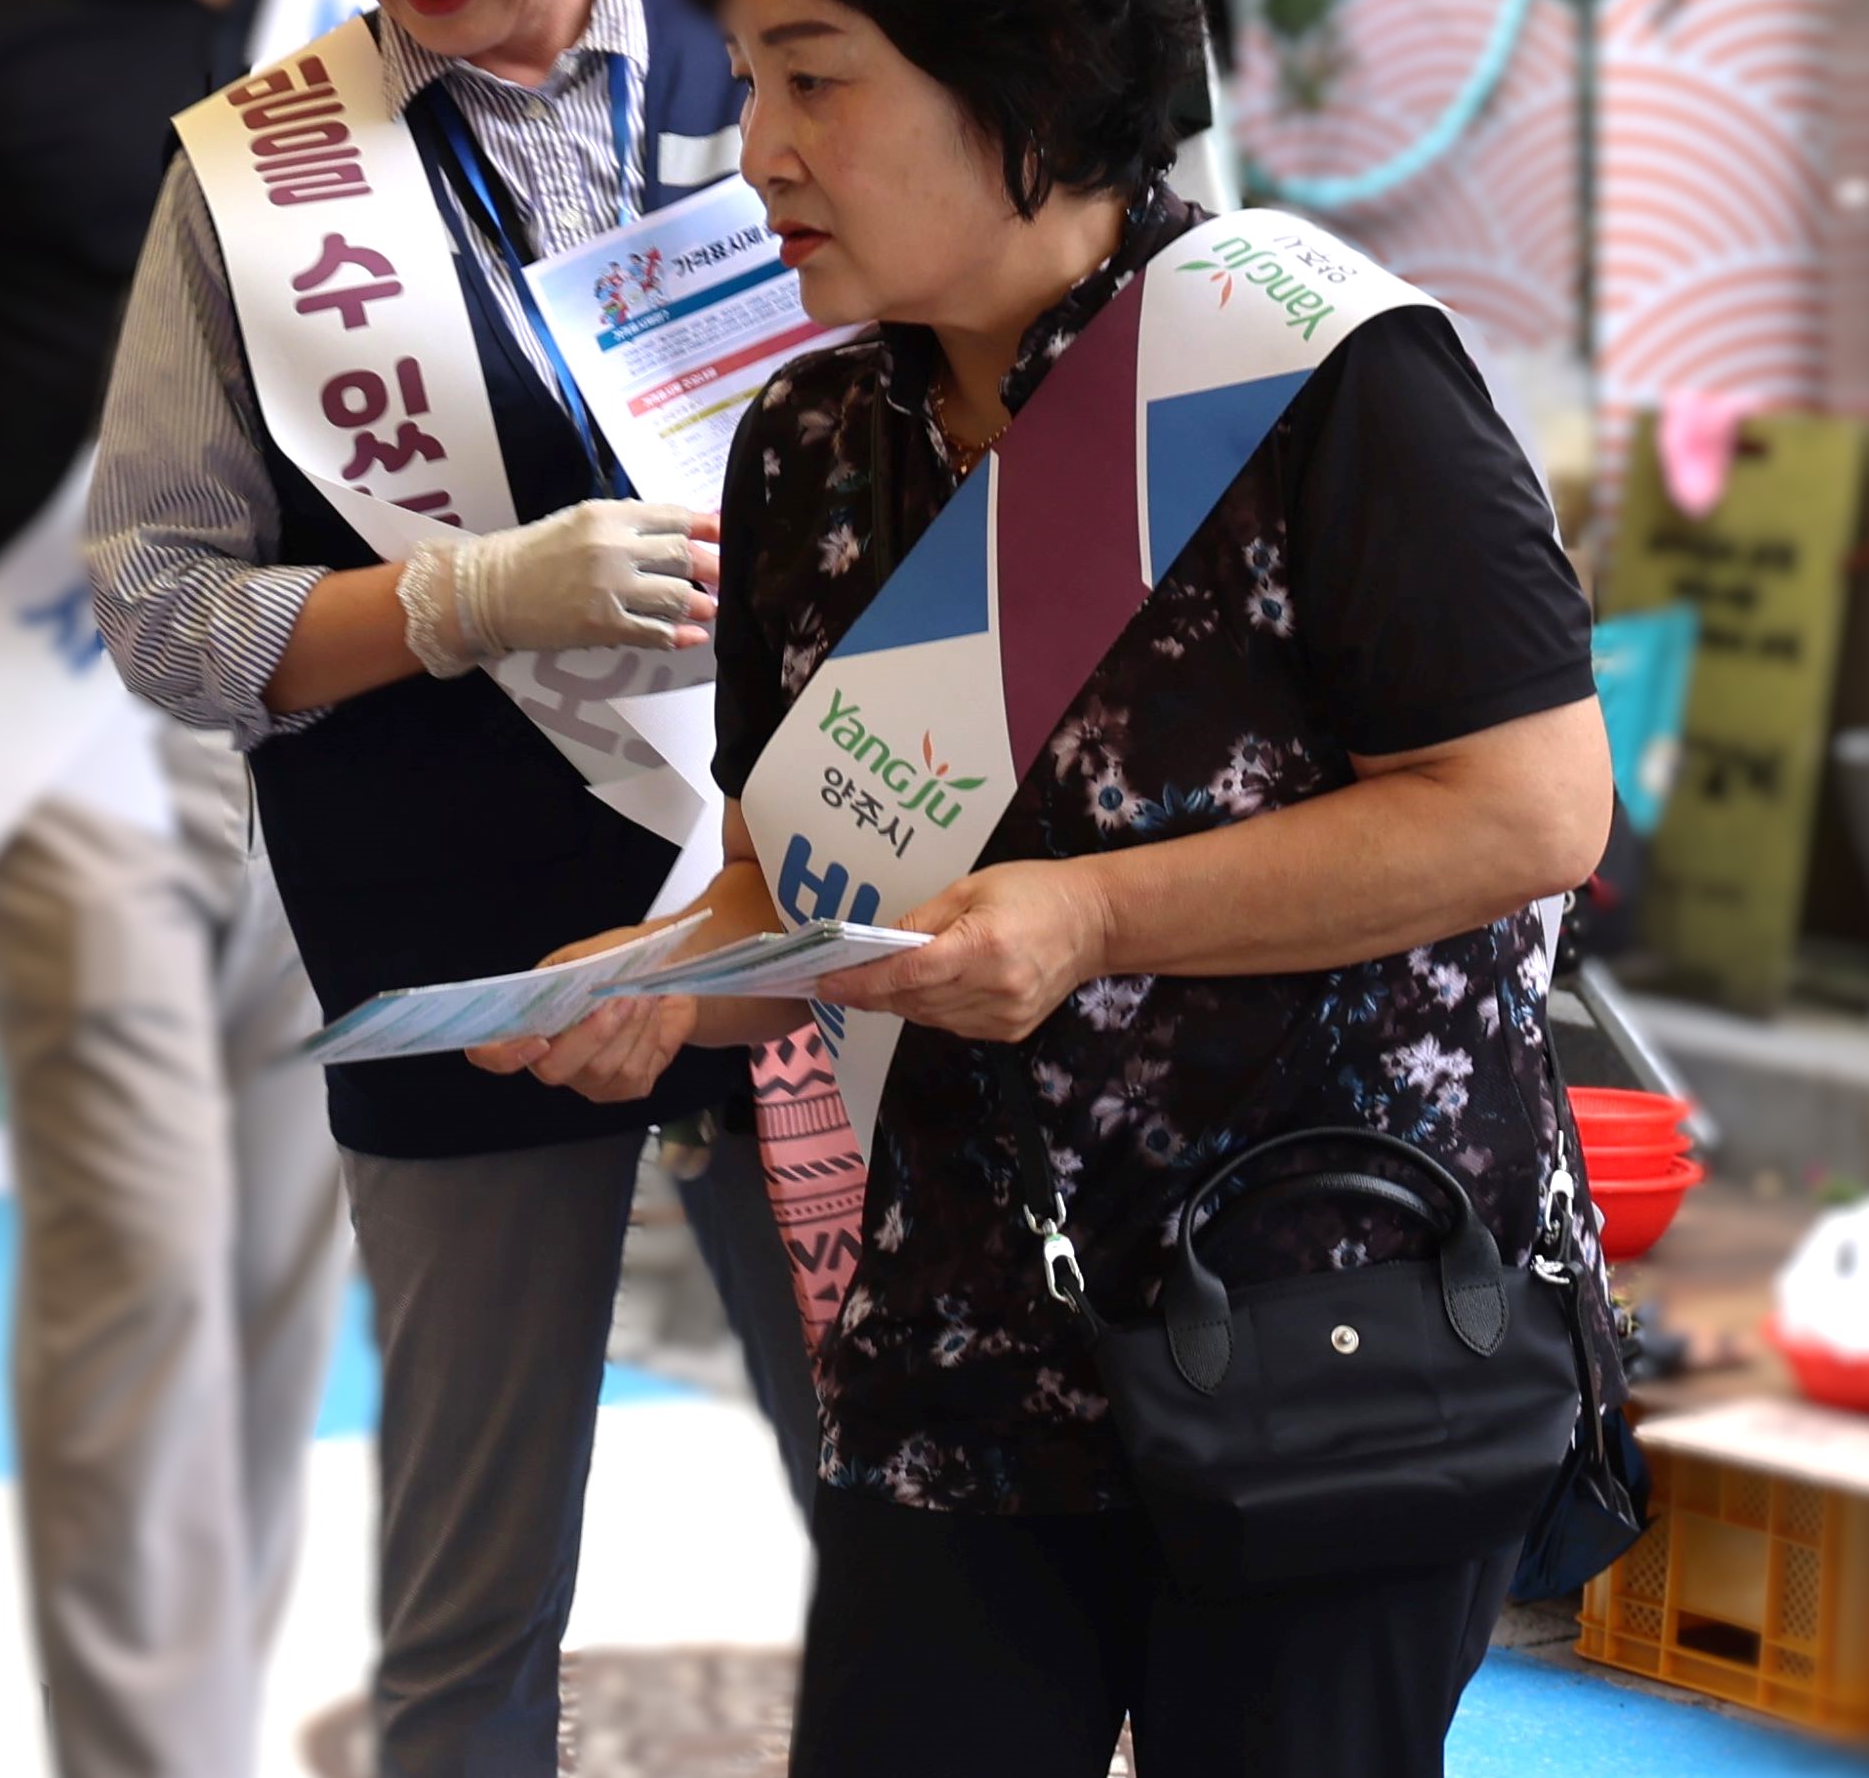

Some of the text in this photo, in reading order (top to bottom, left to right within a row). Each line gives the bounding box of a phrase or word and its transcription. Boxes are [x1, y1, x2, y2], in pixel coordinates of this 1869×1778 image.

[291, 232, 403, 330] 수
[671, 223, 766, 275] 가격표시제
[818, 687, 963, 829] Yangju
[820, 766, 916, 859] 양주시
